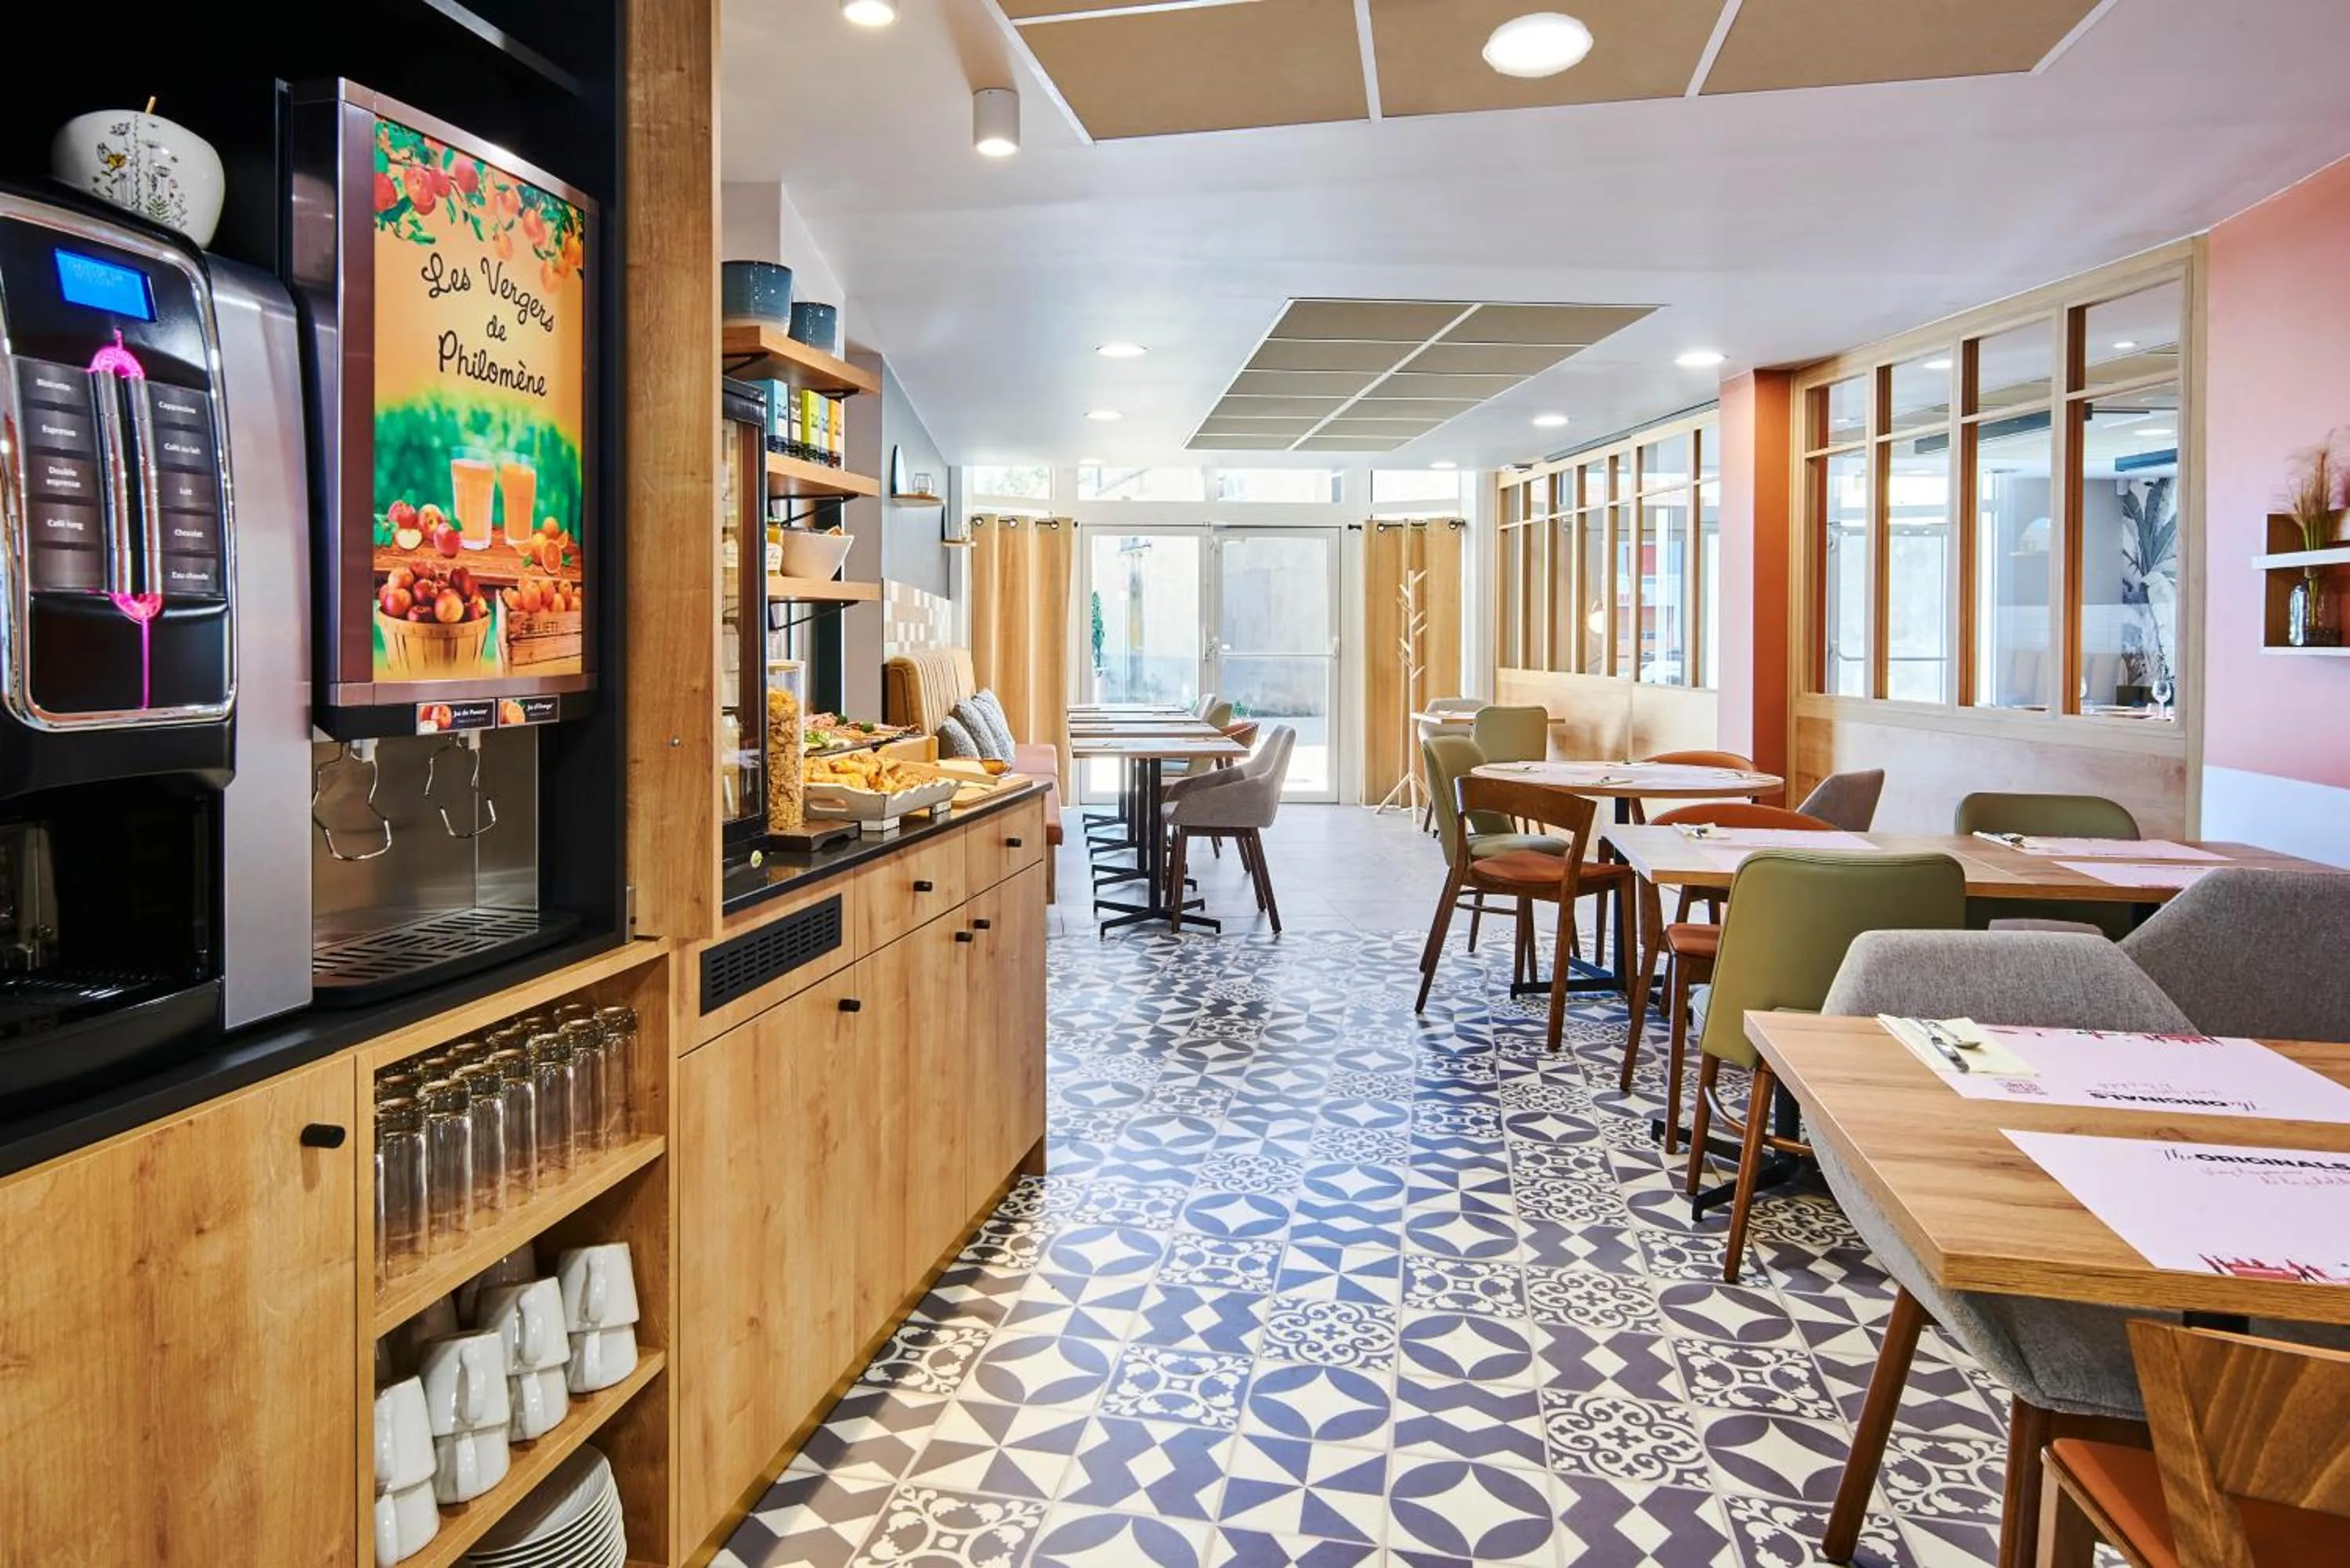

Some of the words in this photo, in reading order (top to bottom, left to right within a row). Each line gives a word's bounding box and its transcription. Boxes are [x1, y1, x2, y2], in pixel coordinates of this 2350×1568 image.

[421, 252, 471, 298] Les
[480, 257, 554, 333] Vergers
[486, 315, 507, 341] de
[438, 330, 548, 396] Philomène
[2089, 1092, 2229, 1107] ORIGINALS
[2194, 1153, 2350, 1172] ORIGINALS
